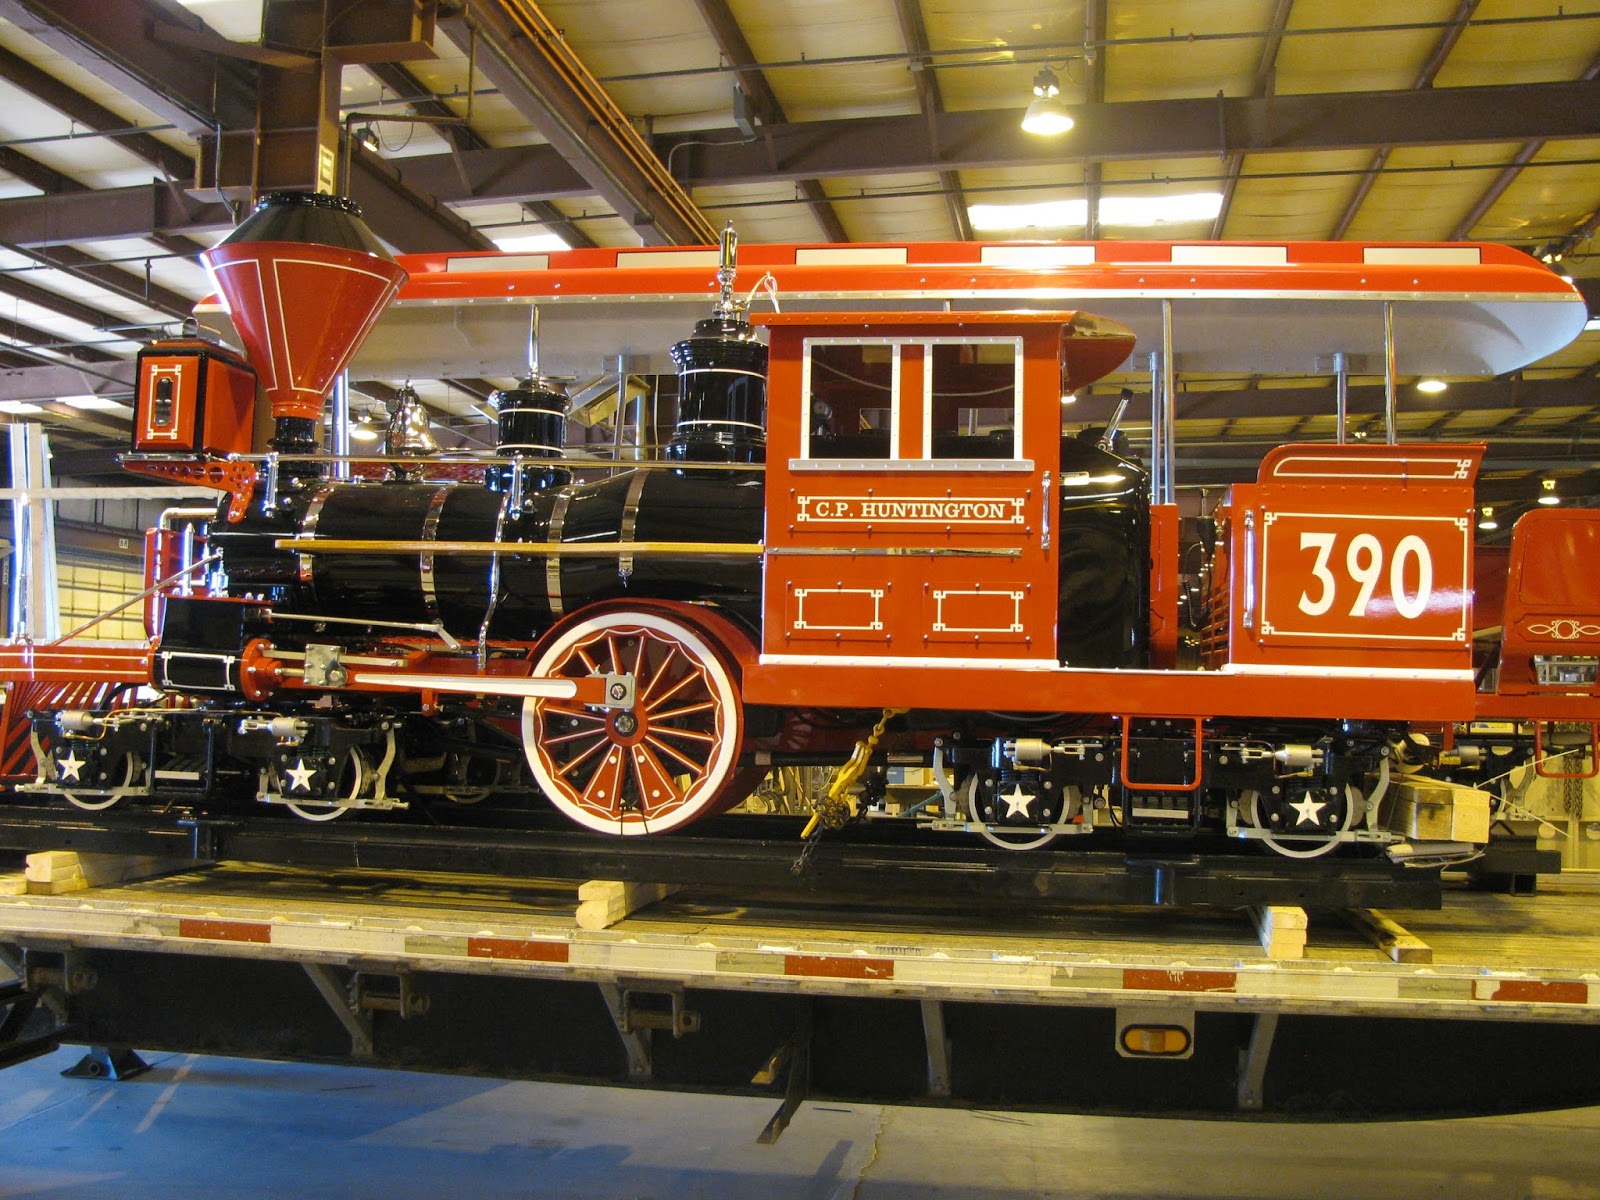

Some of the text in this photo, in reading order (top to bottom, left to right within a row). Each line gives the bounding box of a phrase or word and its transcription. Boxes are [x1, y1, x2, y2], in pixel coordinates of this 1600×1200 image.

[816, 502, 1005, 518] C.P. HUNTINGTON
[1298, 532, 1433, 619] 390
